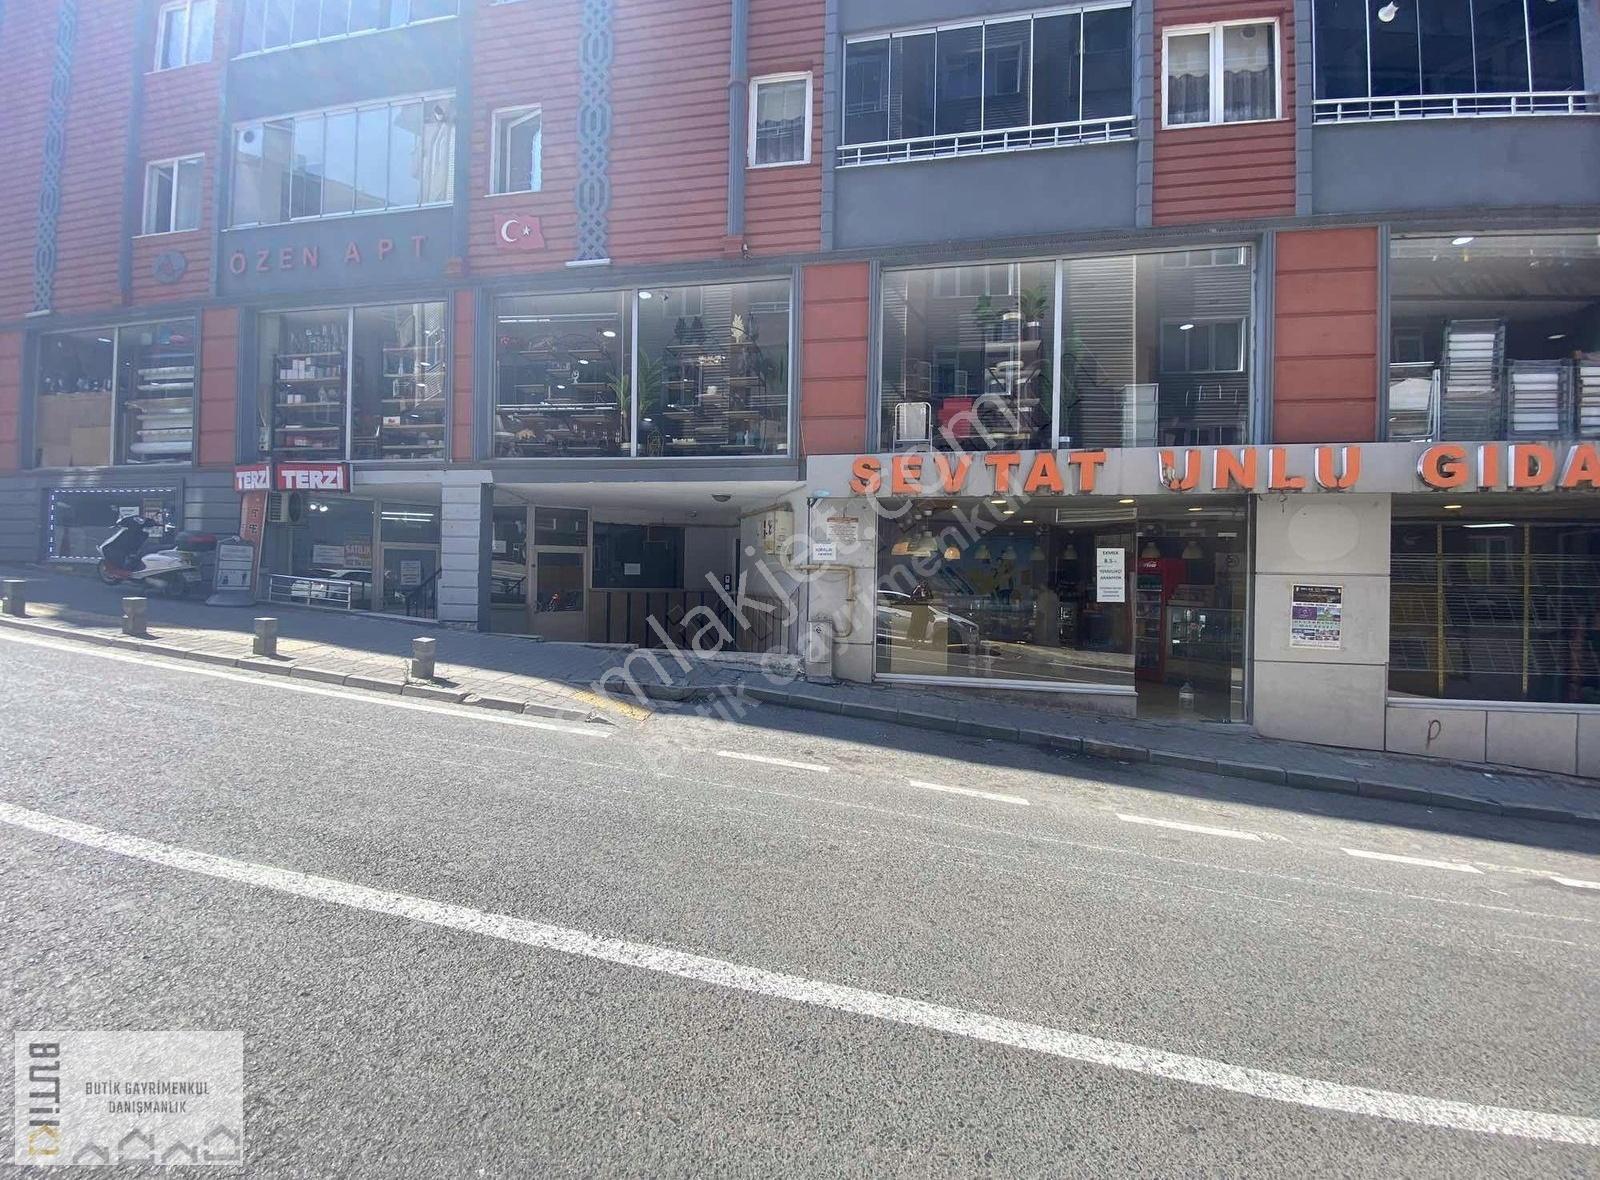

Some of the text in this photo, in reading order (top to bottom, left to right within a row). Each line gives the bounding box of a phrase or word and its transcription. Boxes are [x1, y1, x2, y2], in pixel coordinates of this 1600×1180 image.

[344, 235, 426, 265] APT
[848, 442, 1600, 495] SEVTAT UNLU GIDA
